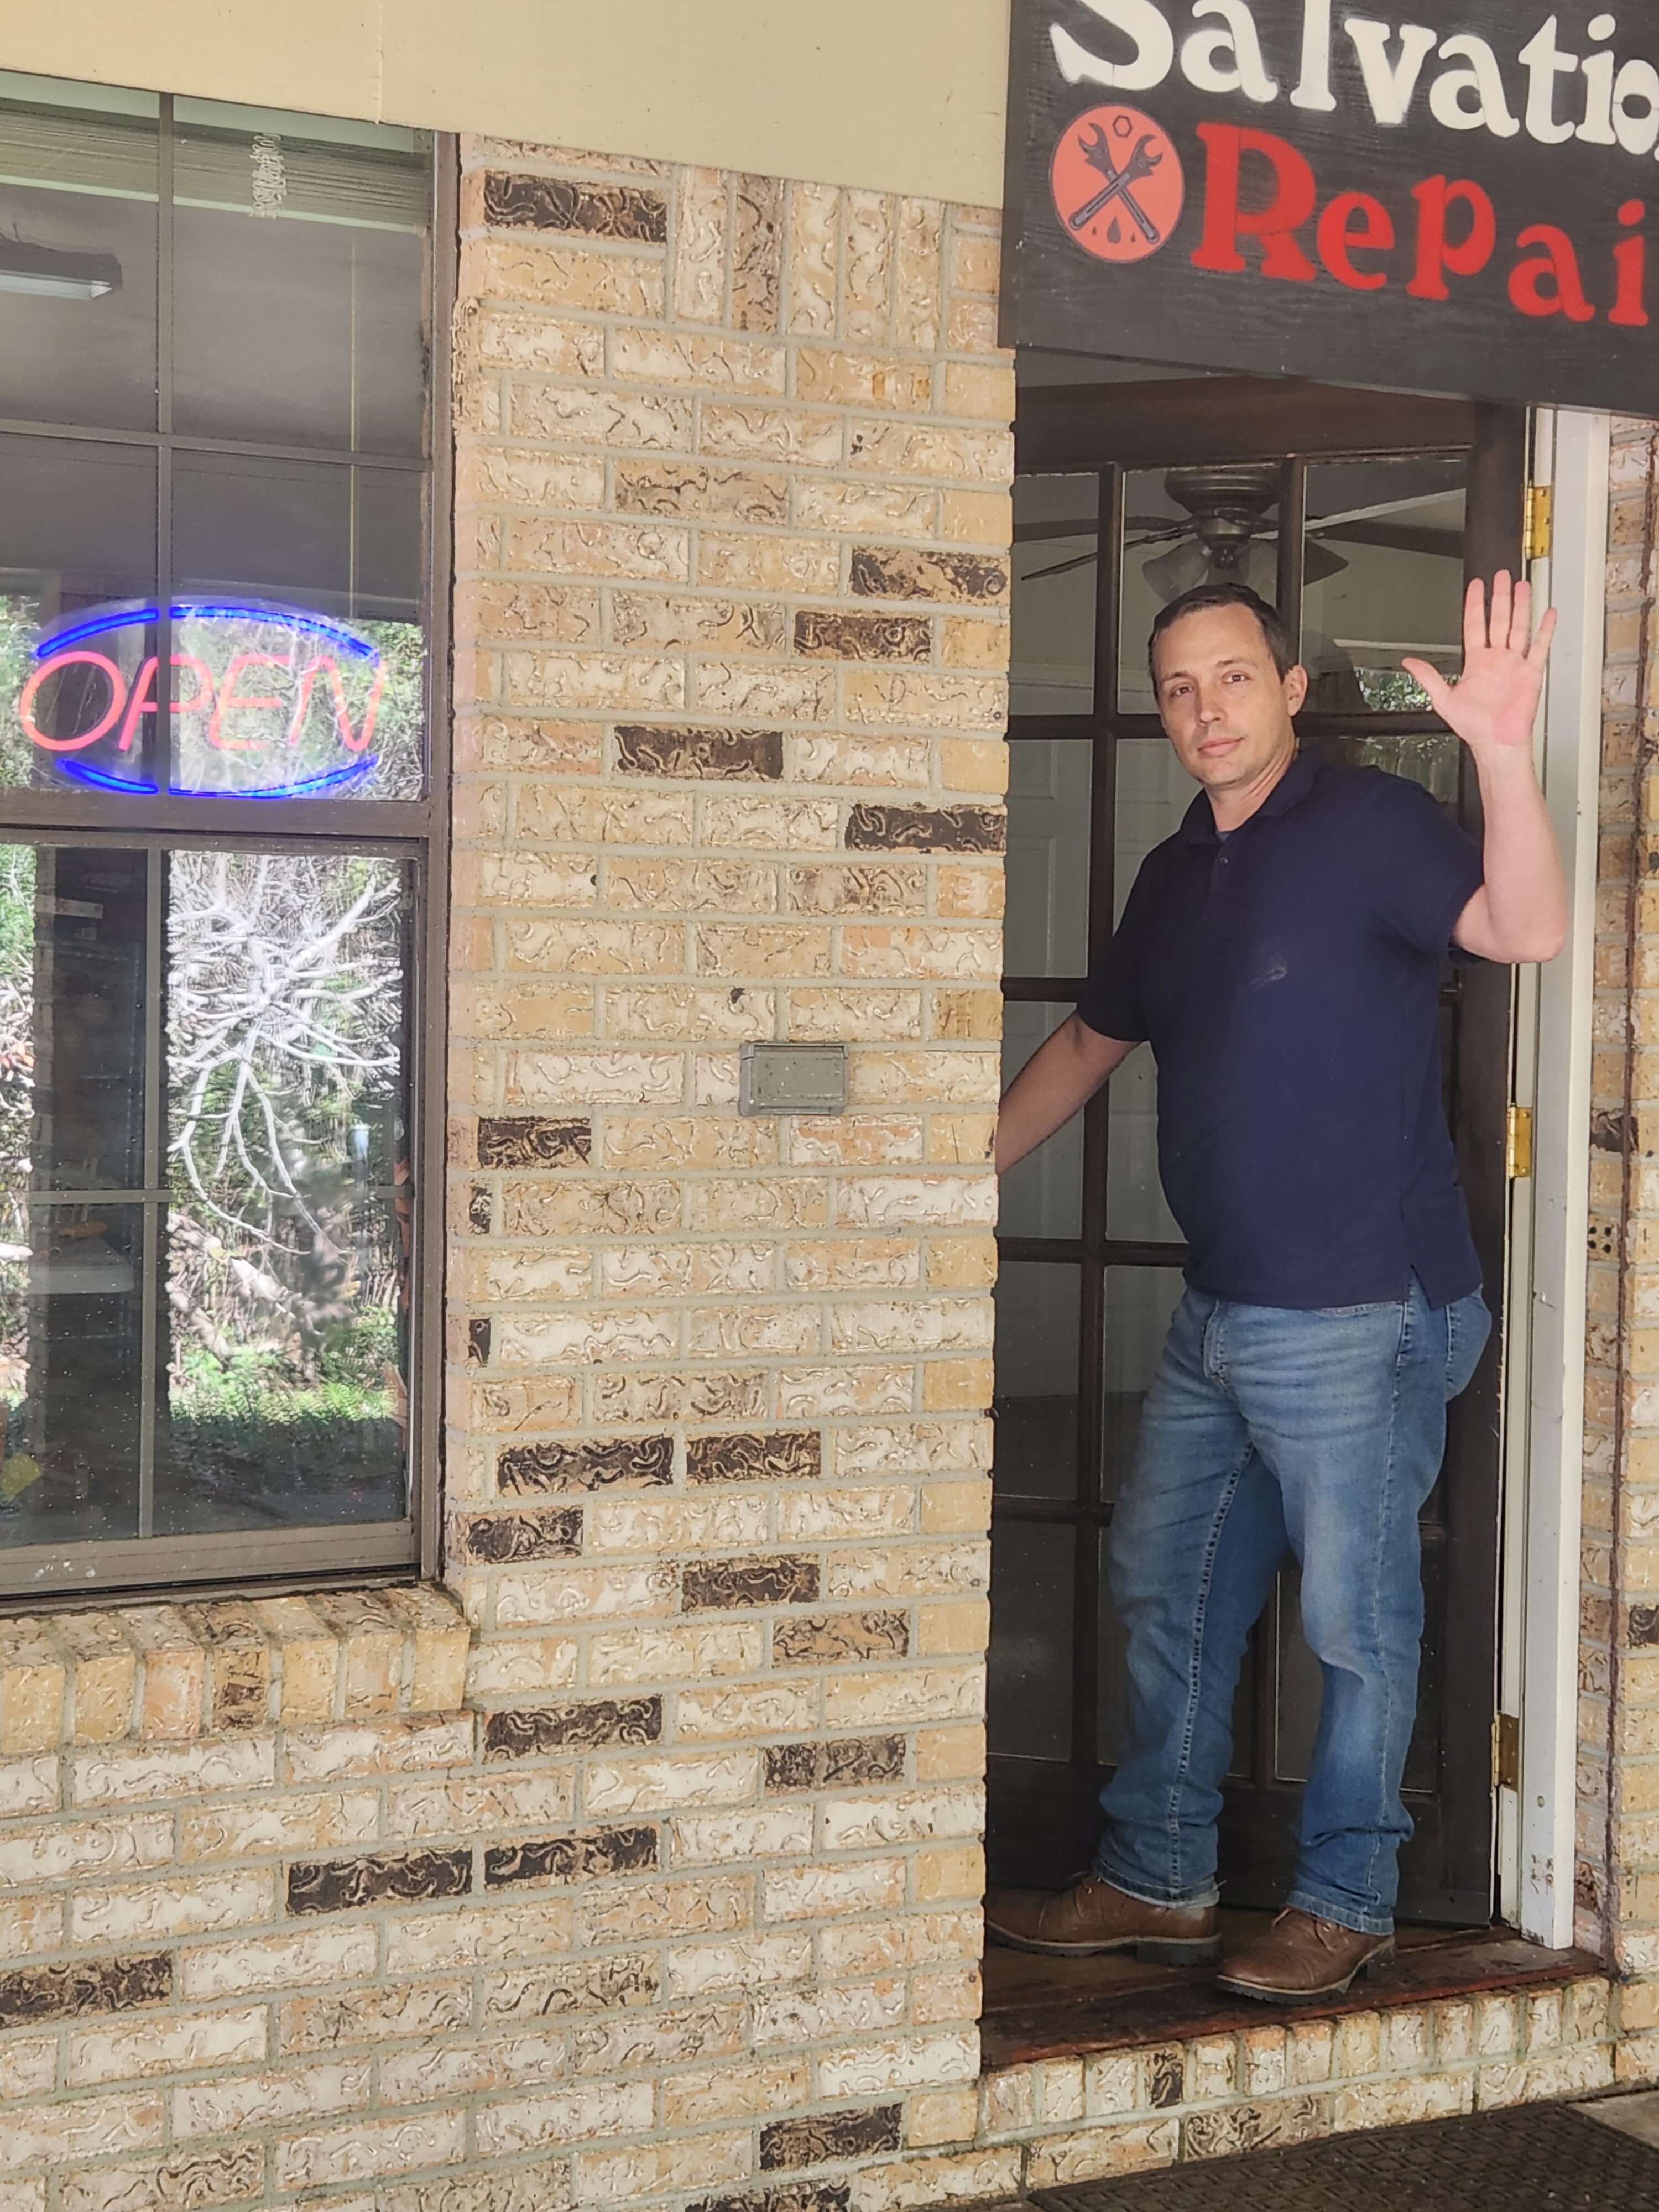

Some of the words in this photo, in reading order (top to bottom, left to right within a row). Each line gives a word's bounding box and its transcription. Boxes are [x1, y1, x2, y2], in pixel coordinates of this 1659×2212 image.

[1050, 0, 1659, 161] Salvatio
[1191, 122, 1648, 326] Repai
[19, 651, 386, 752] OPEN
